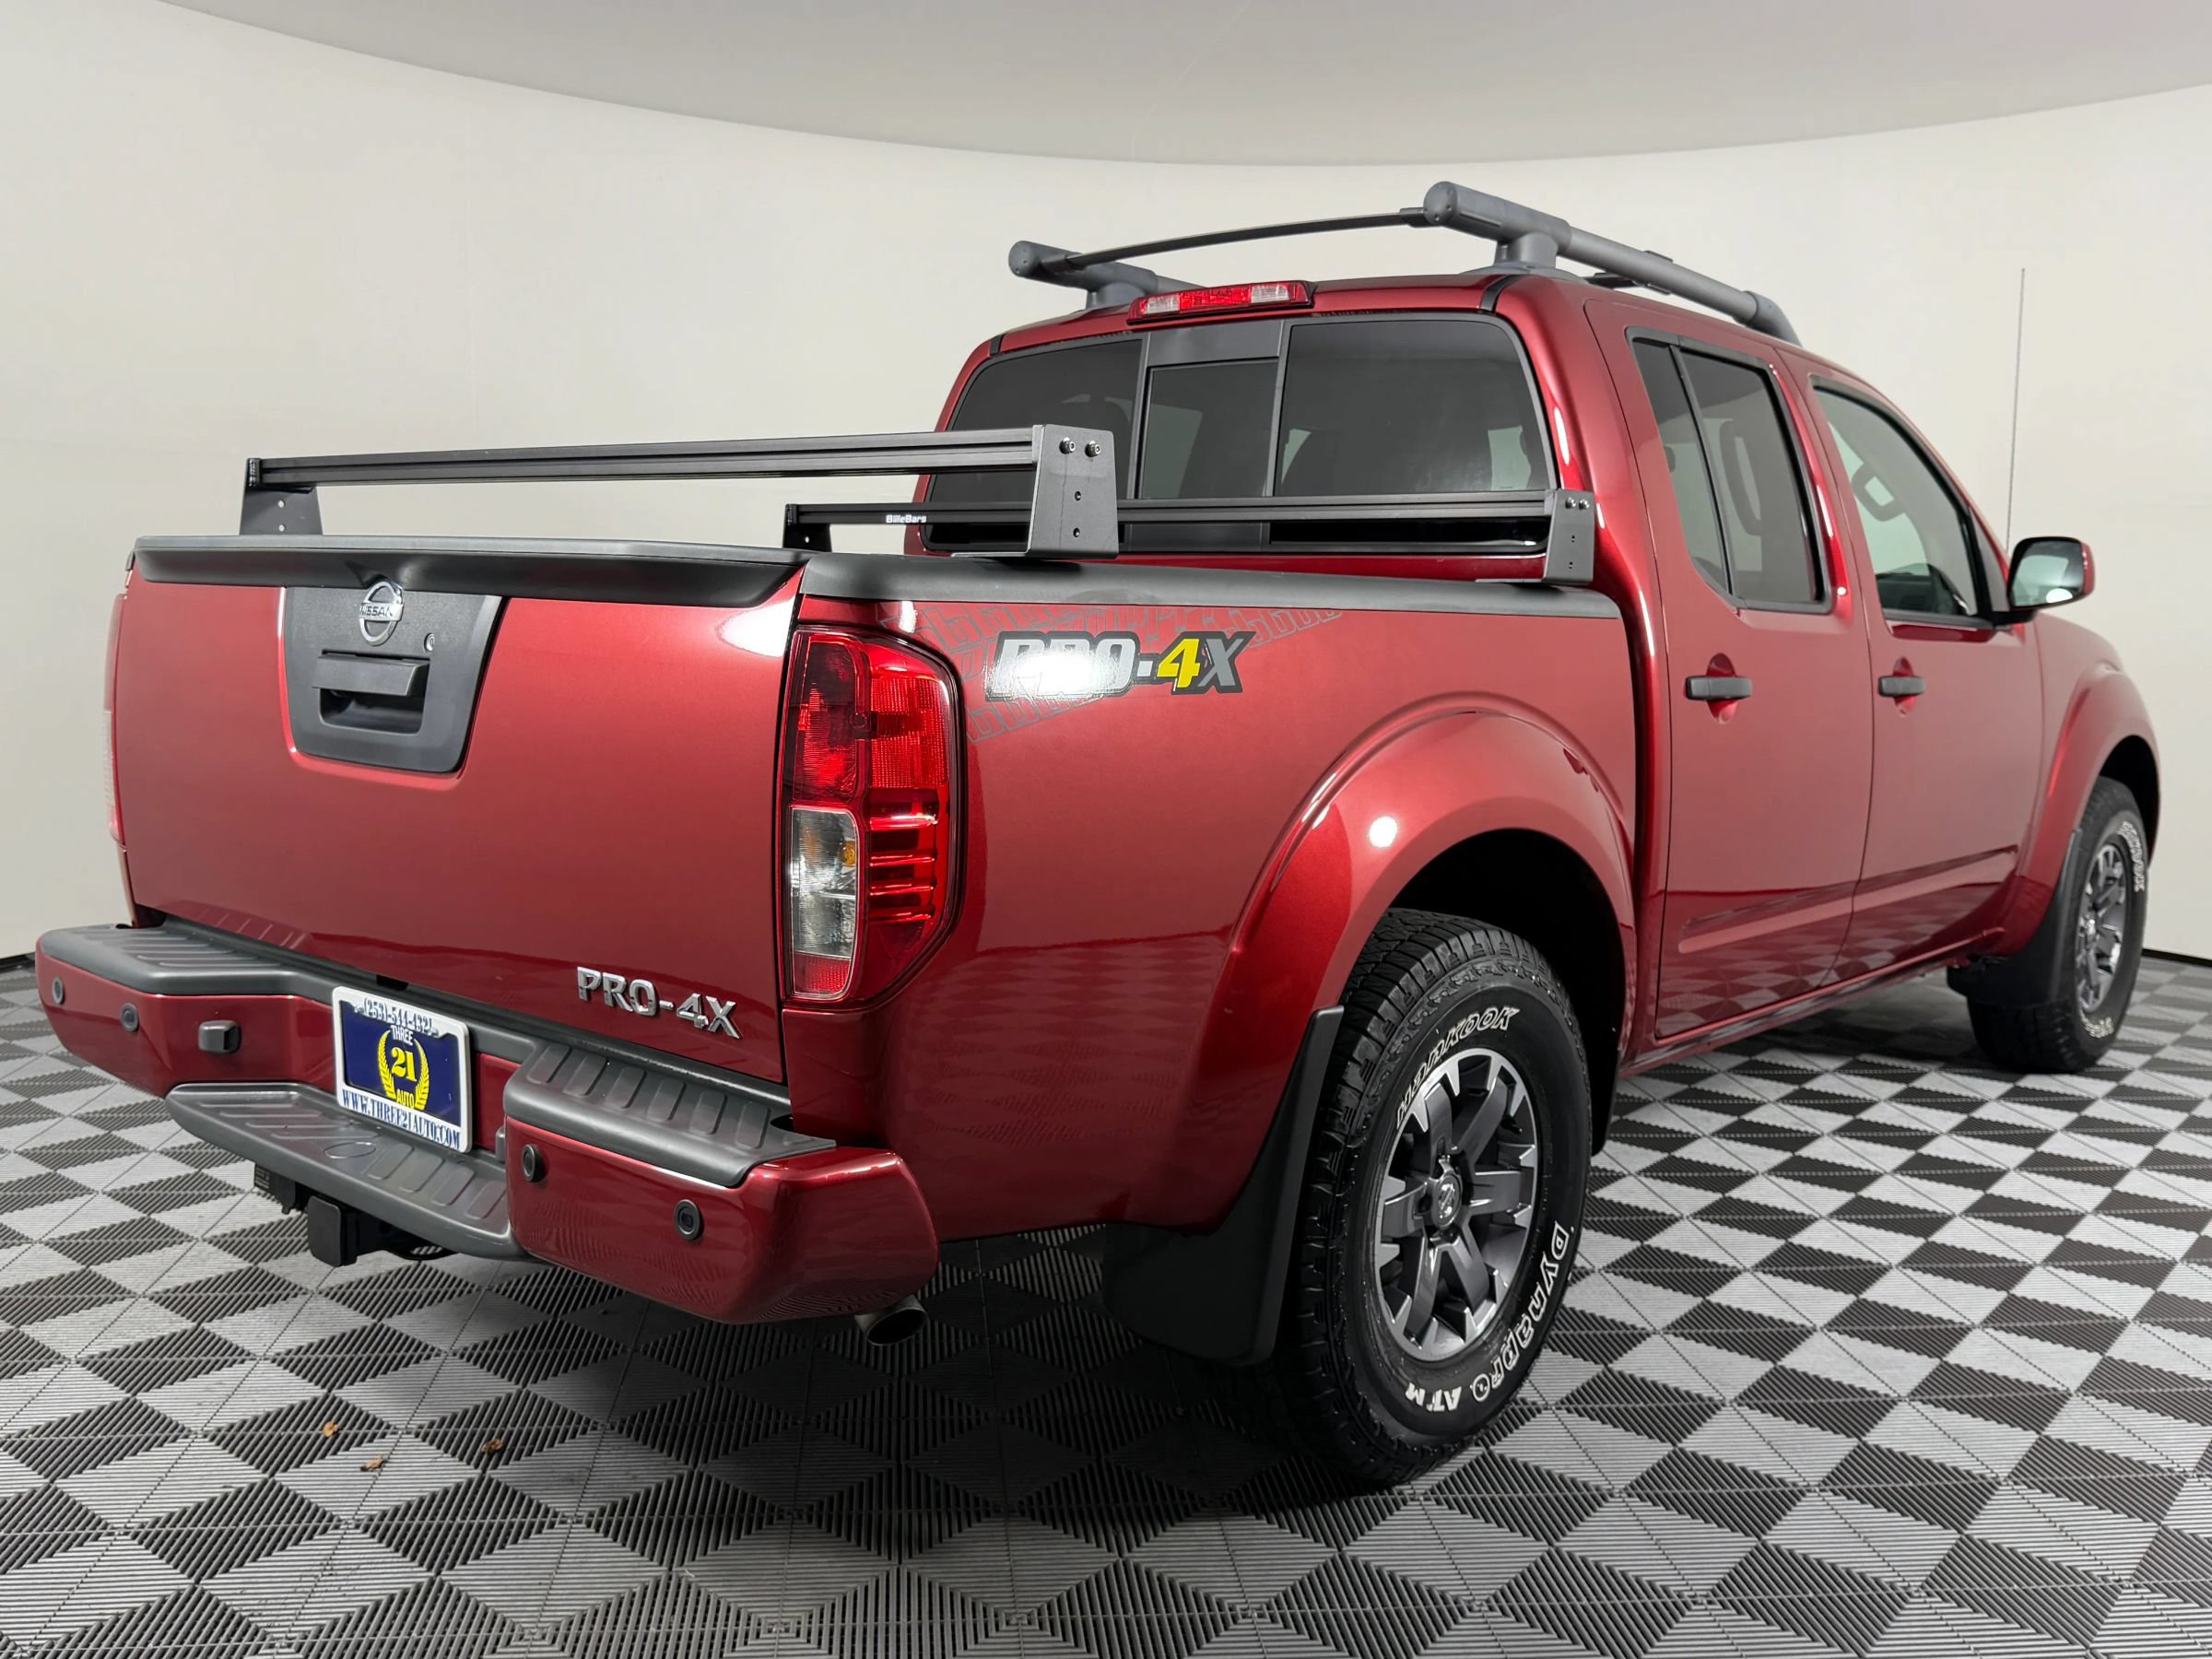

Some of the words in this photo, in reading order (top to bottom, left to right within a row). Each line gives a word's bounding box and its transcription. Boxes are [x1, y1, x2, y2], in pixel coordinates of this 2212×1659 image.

[359, 605, 395, 618] NISSAN
[577, 966, 740, 1039] PRO-4X
[390, 1025, 414, 1046] THREE
[391, 1047, 418, 1082] 21
[396, 1088, 416, 1110] AUTO
